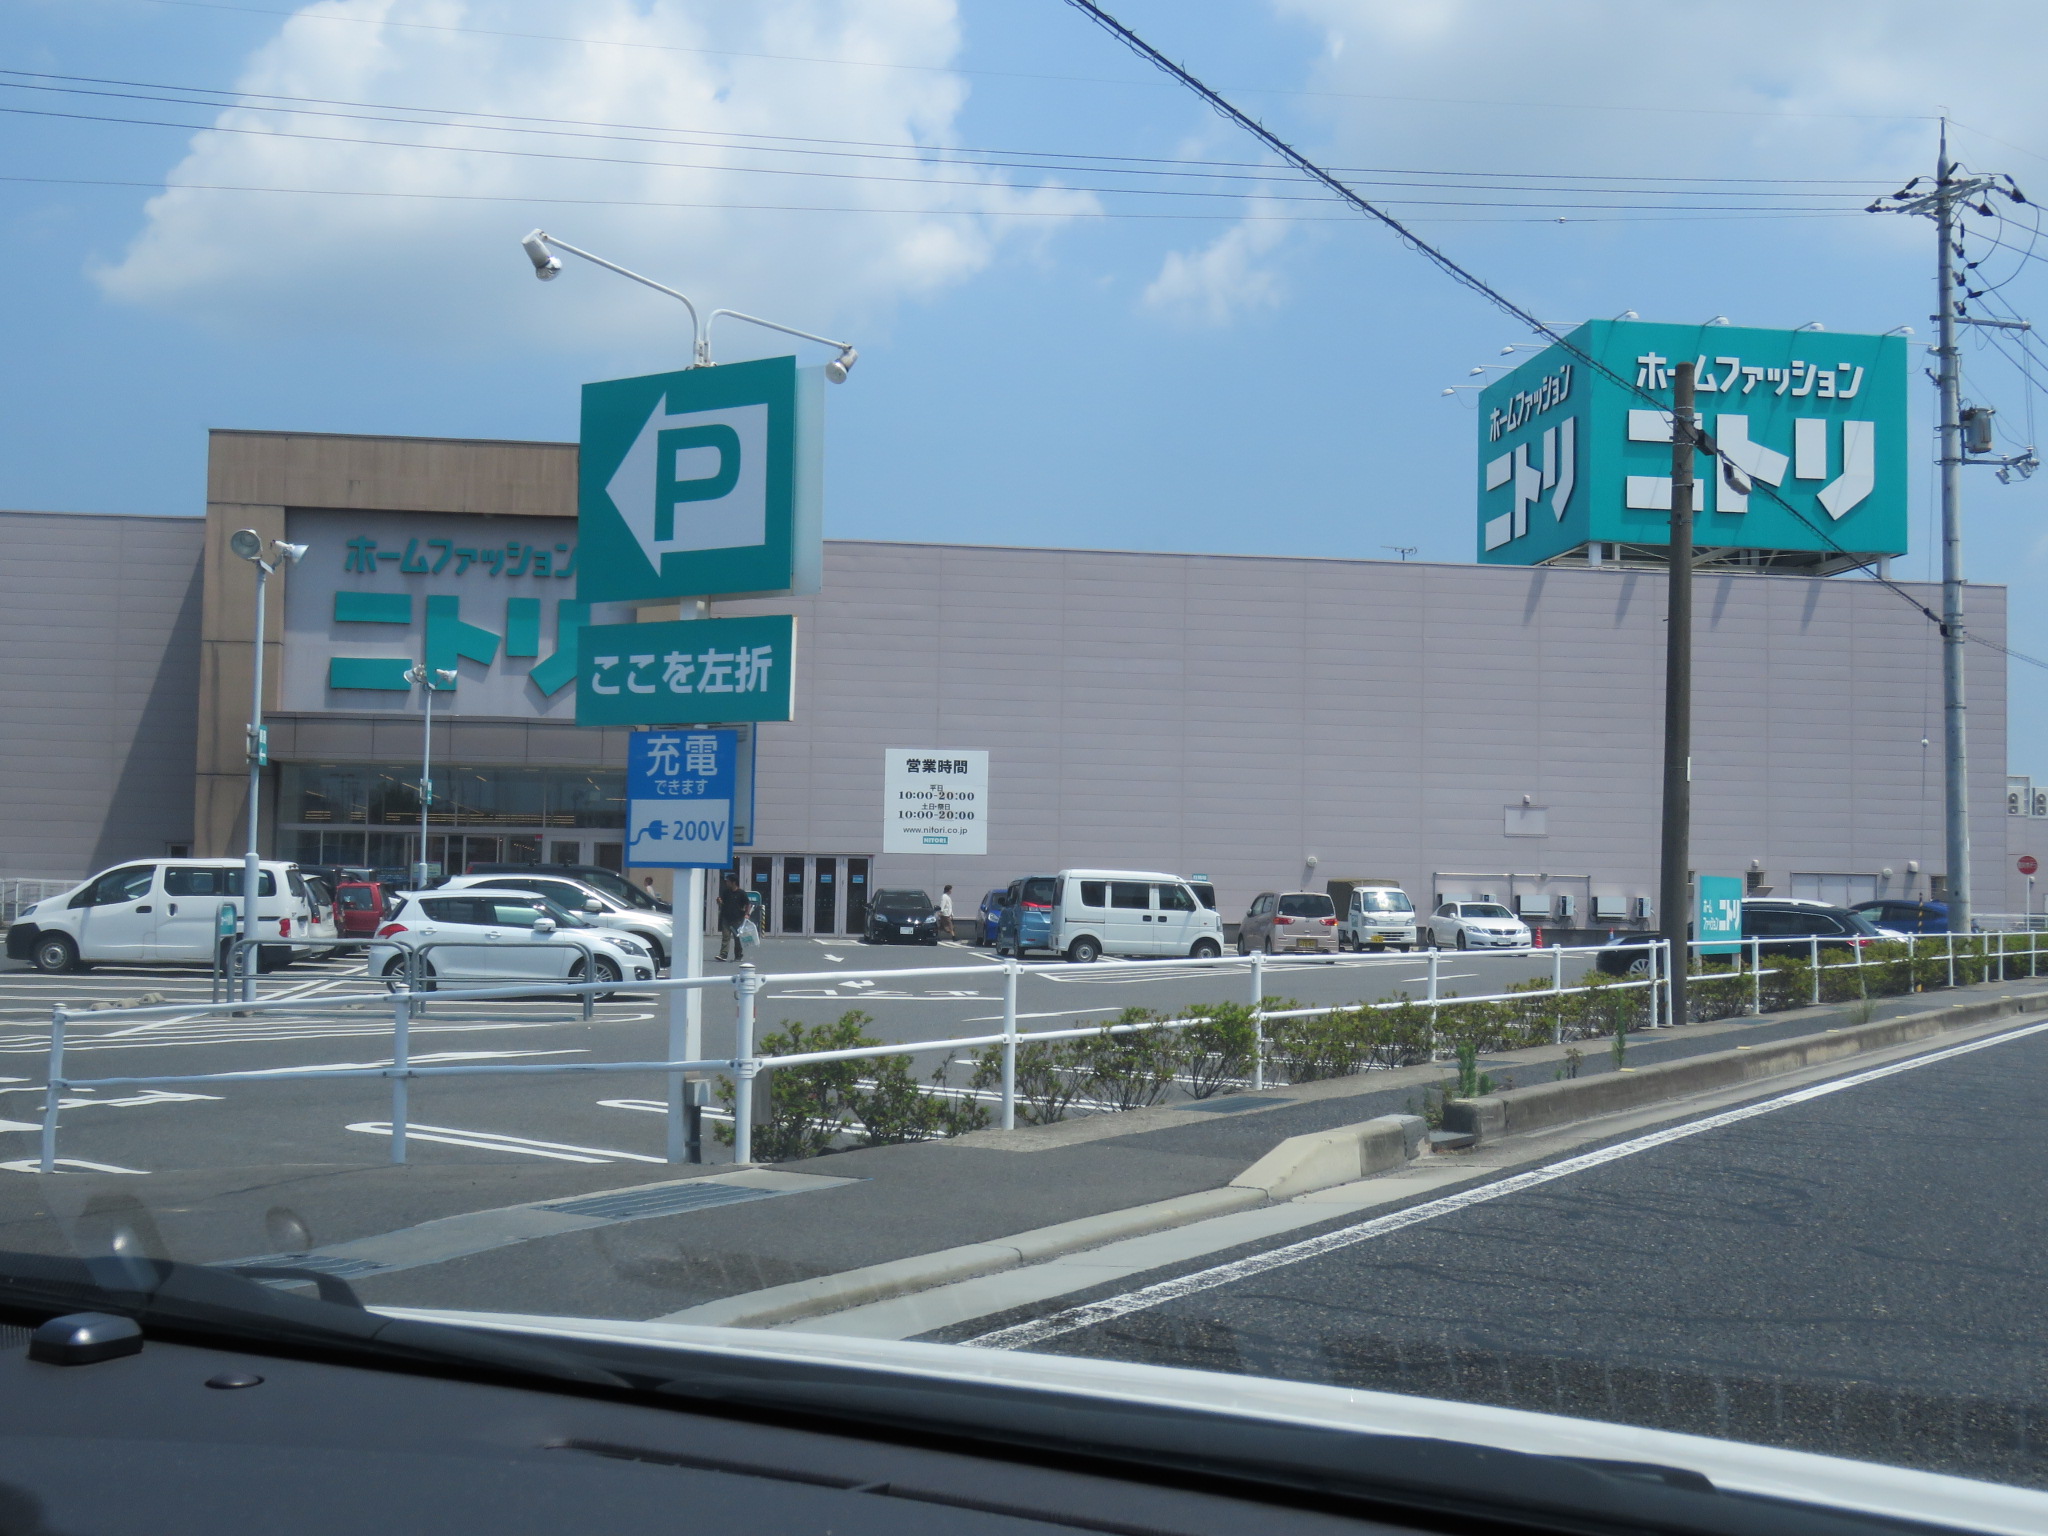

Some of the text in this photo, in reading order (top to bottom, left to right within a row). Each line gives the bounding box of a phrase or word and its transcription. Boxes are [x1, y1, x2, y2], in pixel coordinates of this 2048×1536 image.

[1489, 364, 1571, 443] ホームファッション
[653, 423, 742, 542] P
[1484, 415, 1575, 552] ニトリ
[1626, 408, 1875, 522] ニトリ
[344, 535, 578, 578] ホームファッション
[330, 590, 590, 698] ニトリ
[592, 645, 773, 695] ここを左折
[646, 734, 719, 777] 充電
[906, 758, 967, 774] 営業時間
[654, 779, 709, 796] できます
[898, 790, 975, 801] 10:00-20:00
[673, 820, 726, 842] 200V
[898, 810, 975, 820] 10:00-20:00
[903, 826, 968, 835] www.nitori.co.jp
[1718, 899, 1741, 931] ニトリ
